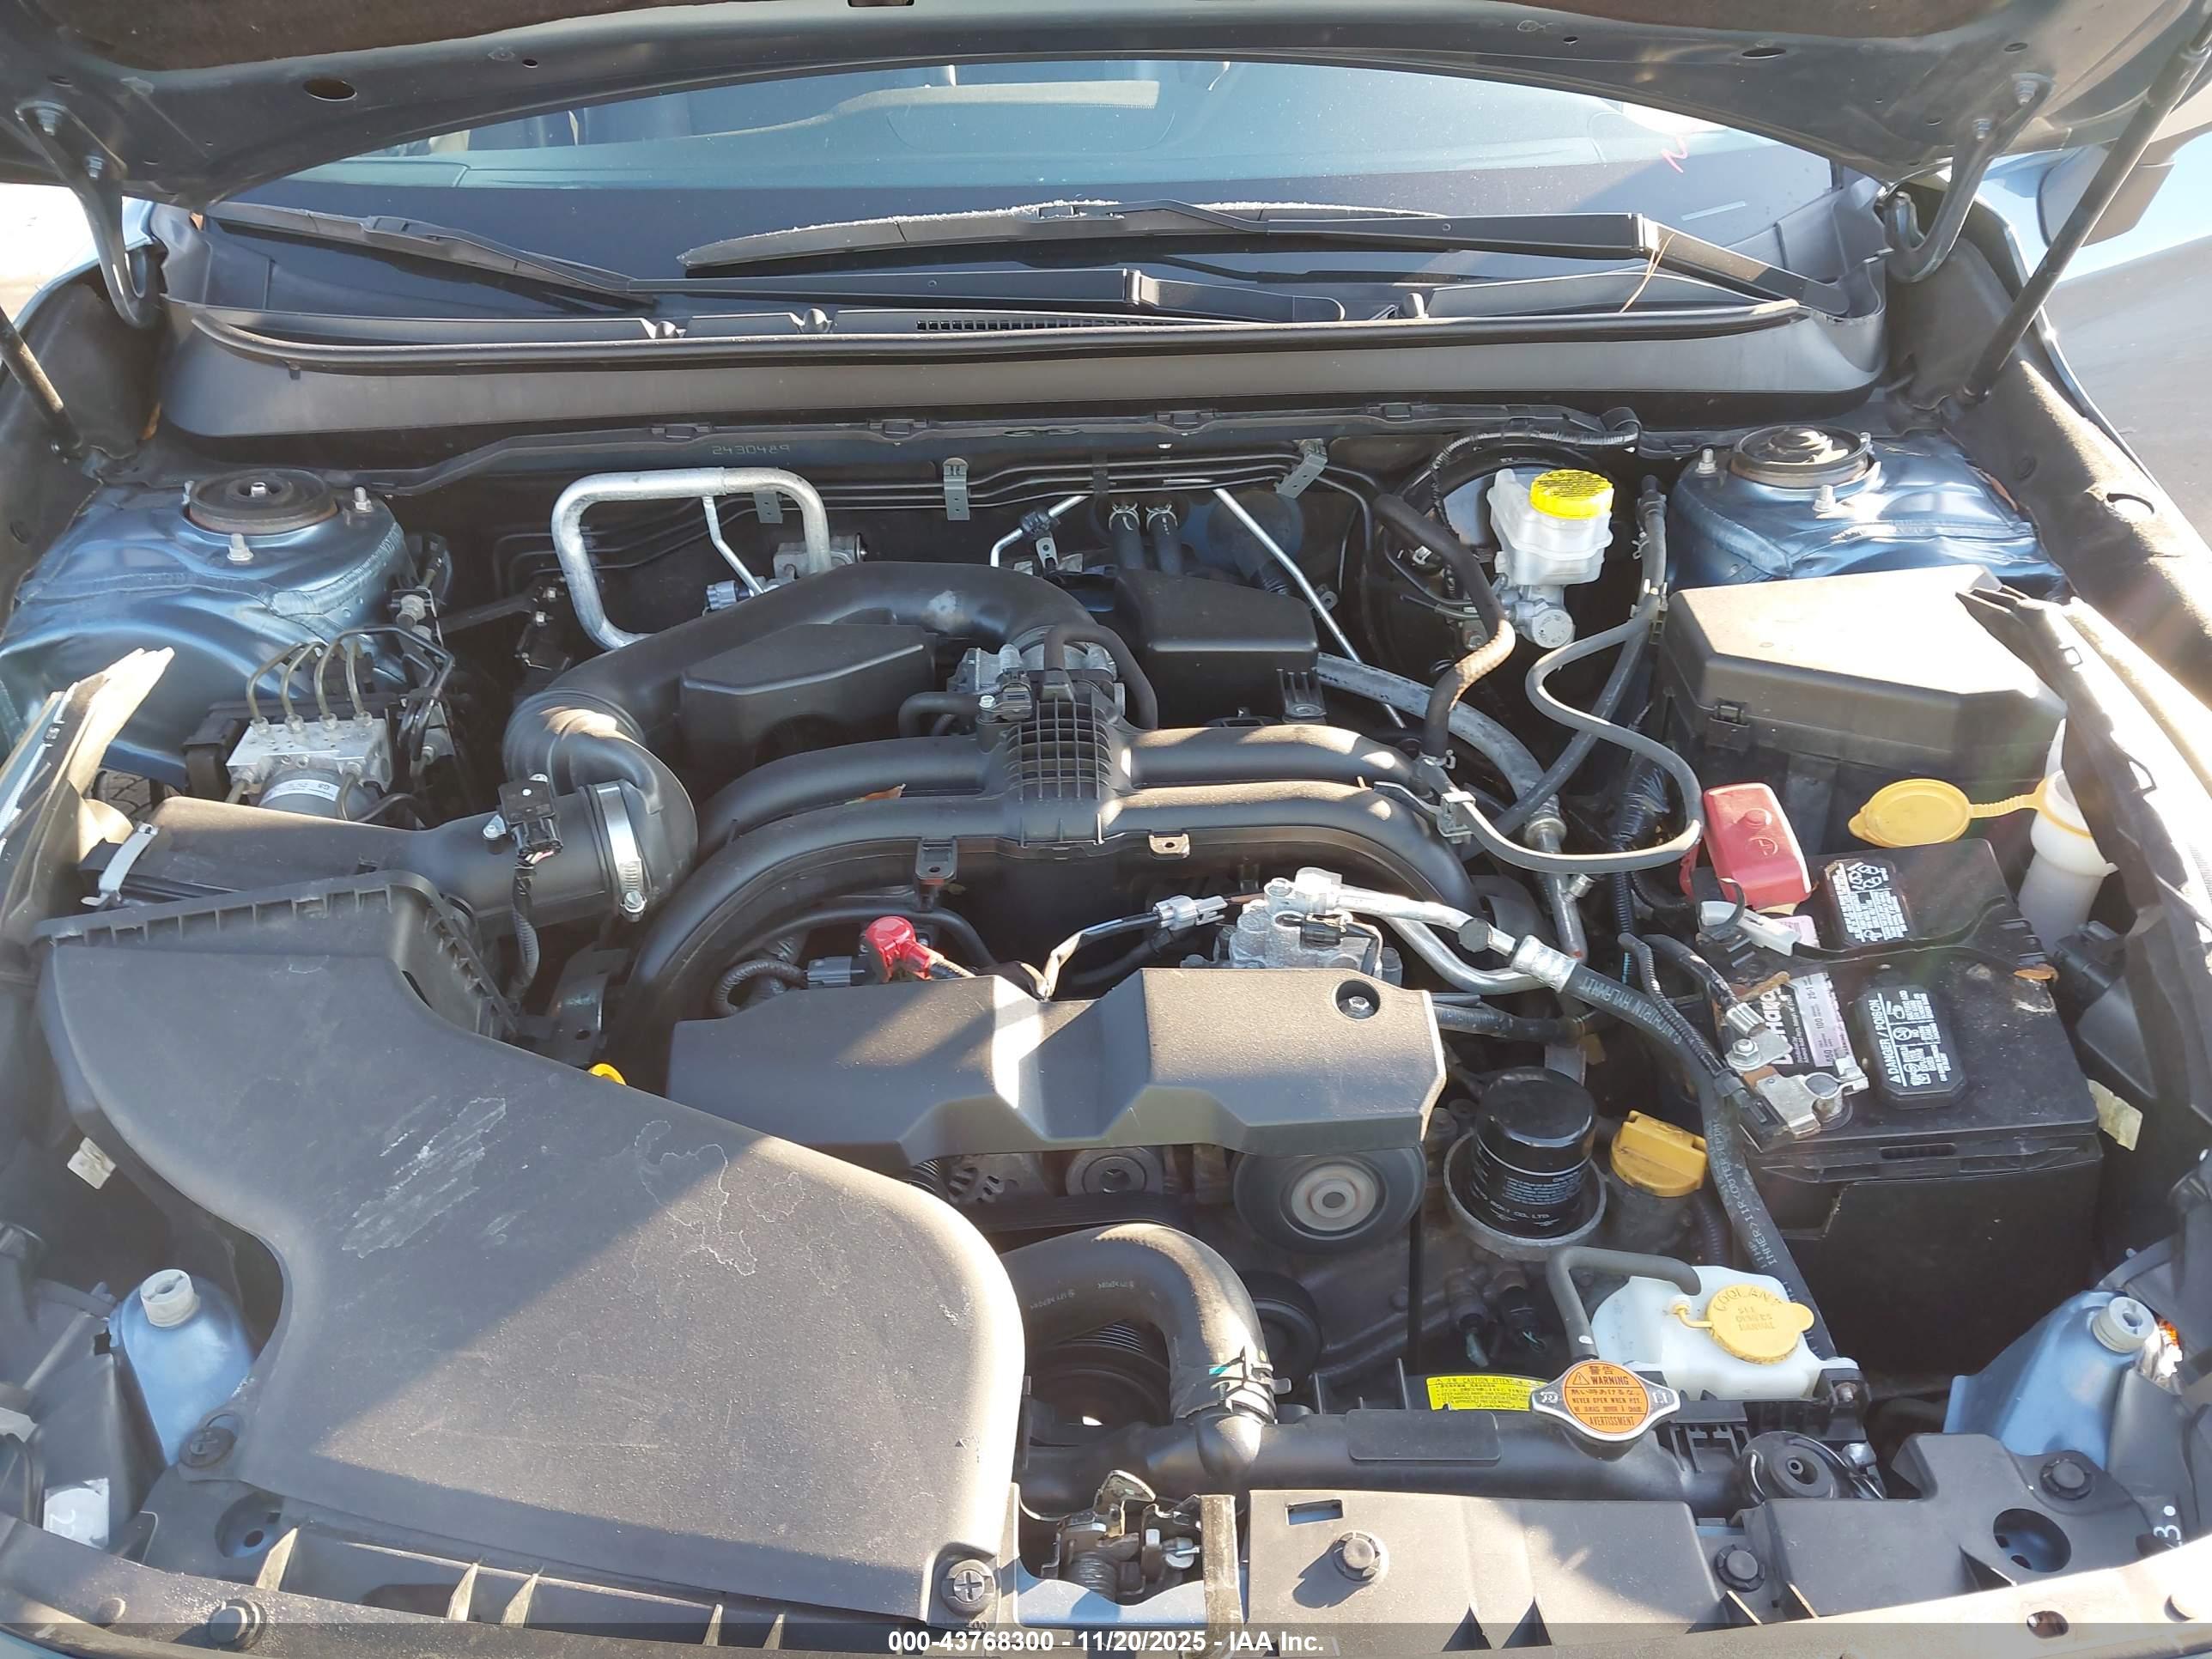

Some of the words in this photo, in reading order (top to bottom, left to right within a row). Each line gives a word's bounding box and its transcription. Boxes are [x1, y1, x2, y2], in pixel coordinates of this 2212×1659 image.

[1869, 1000, 1887, 1030] POISON
[1879, 1038, 1900, 1074] DANGER
[1590, 1376, 1630, 1385] WARNING
